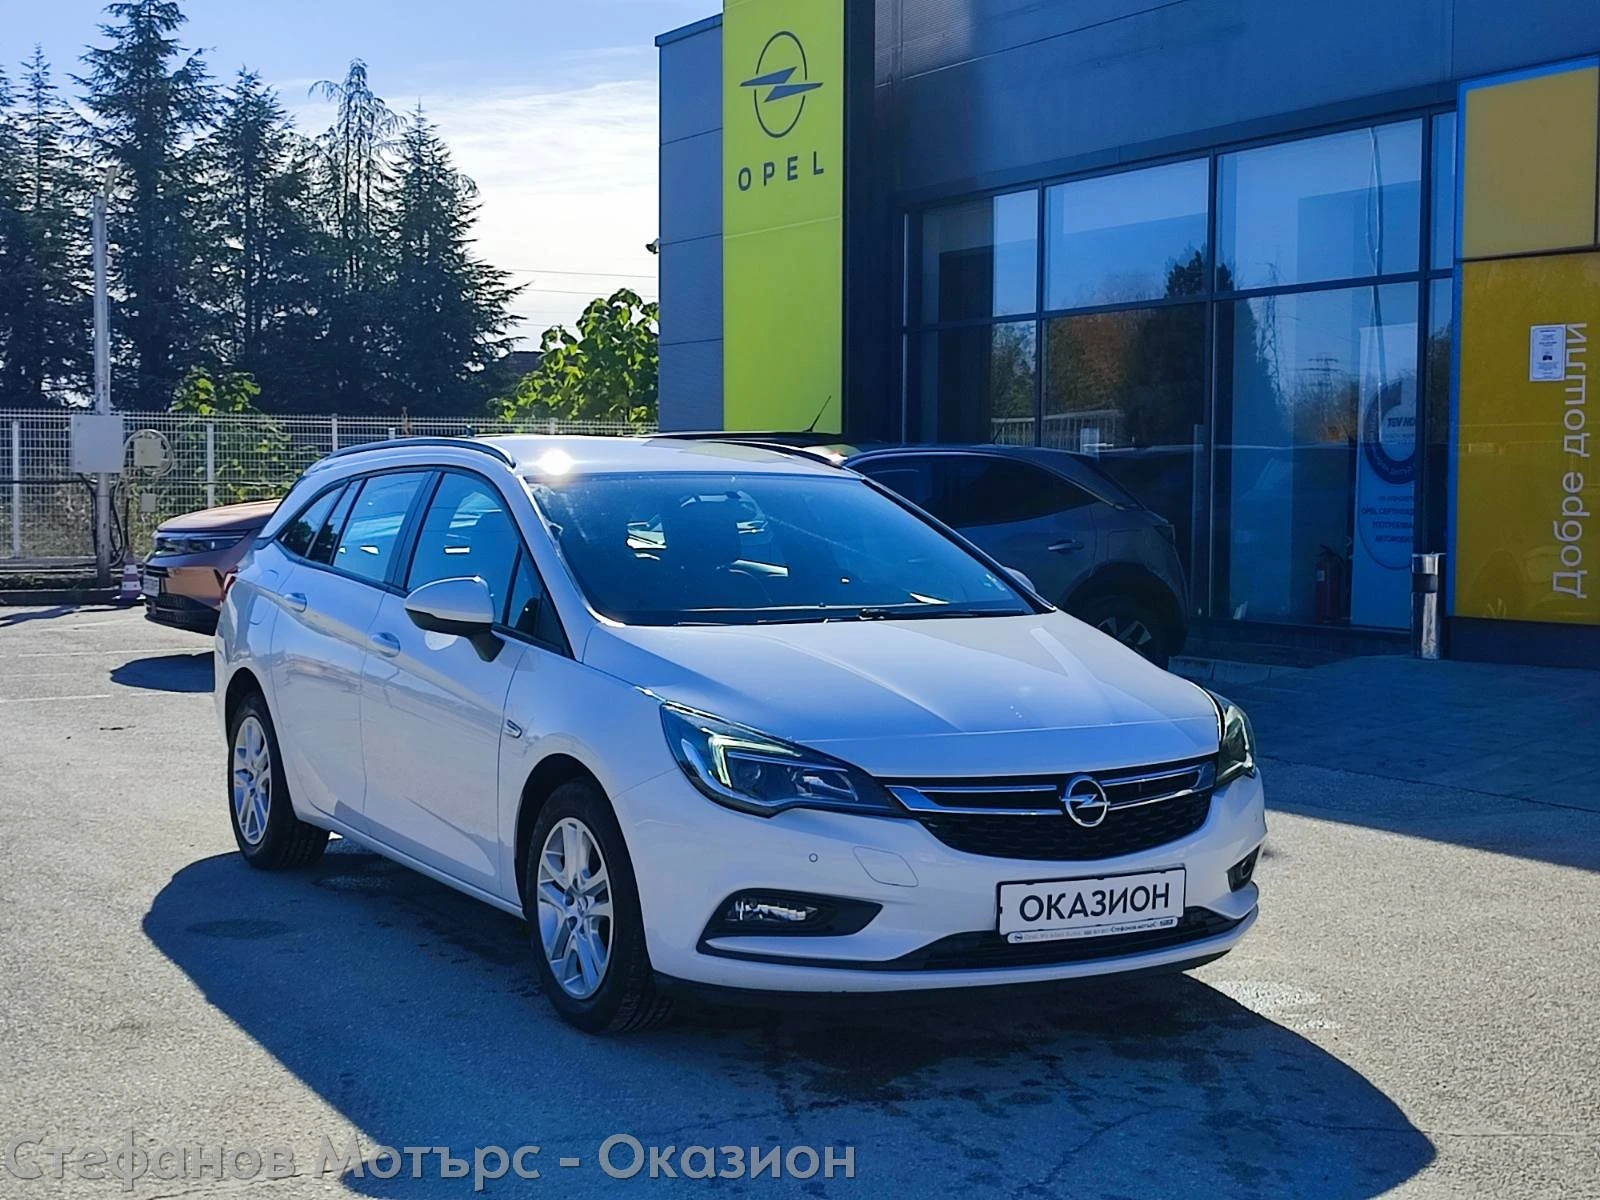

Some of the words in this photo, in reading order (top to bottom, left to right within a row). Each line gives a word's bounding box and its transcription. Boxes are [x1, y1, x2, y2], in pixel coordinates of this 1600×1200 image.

[738, 151, 824, 191] OPEL
[1564, 323, 1590, 457] дошли
[1553, 472, 1590, 598] Добре
[1019, 882, 1170, 922] ОКАЗИОН
